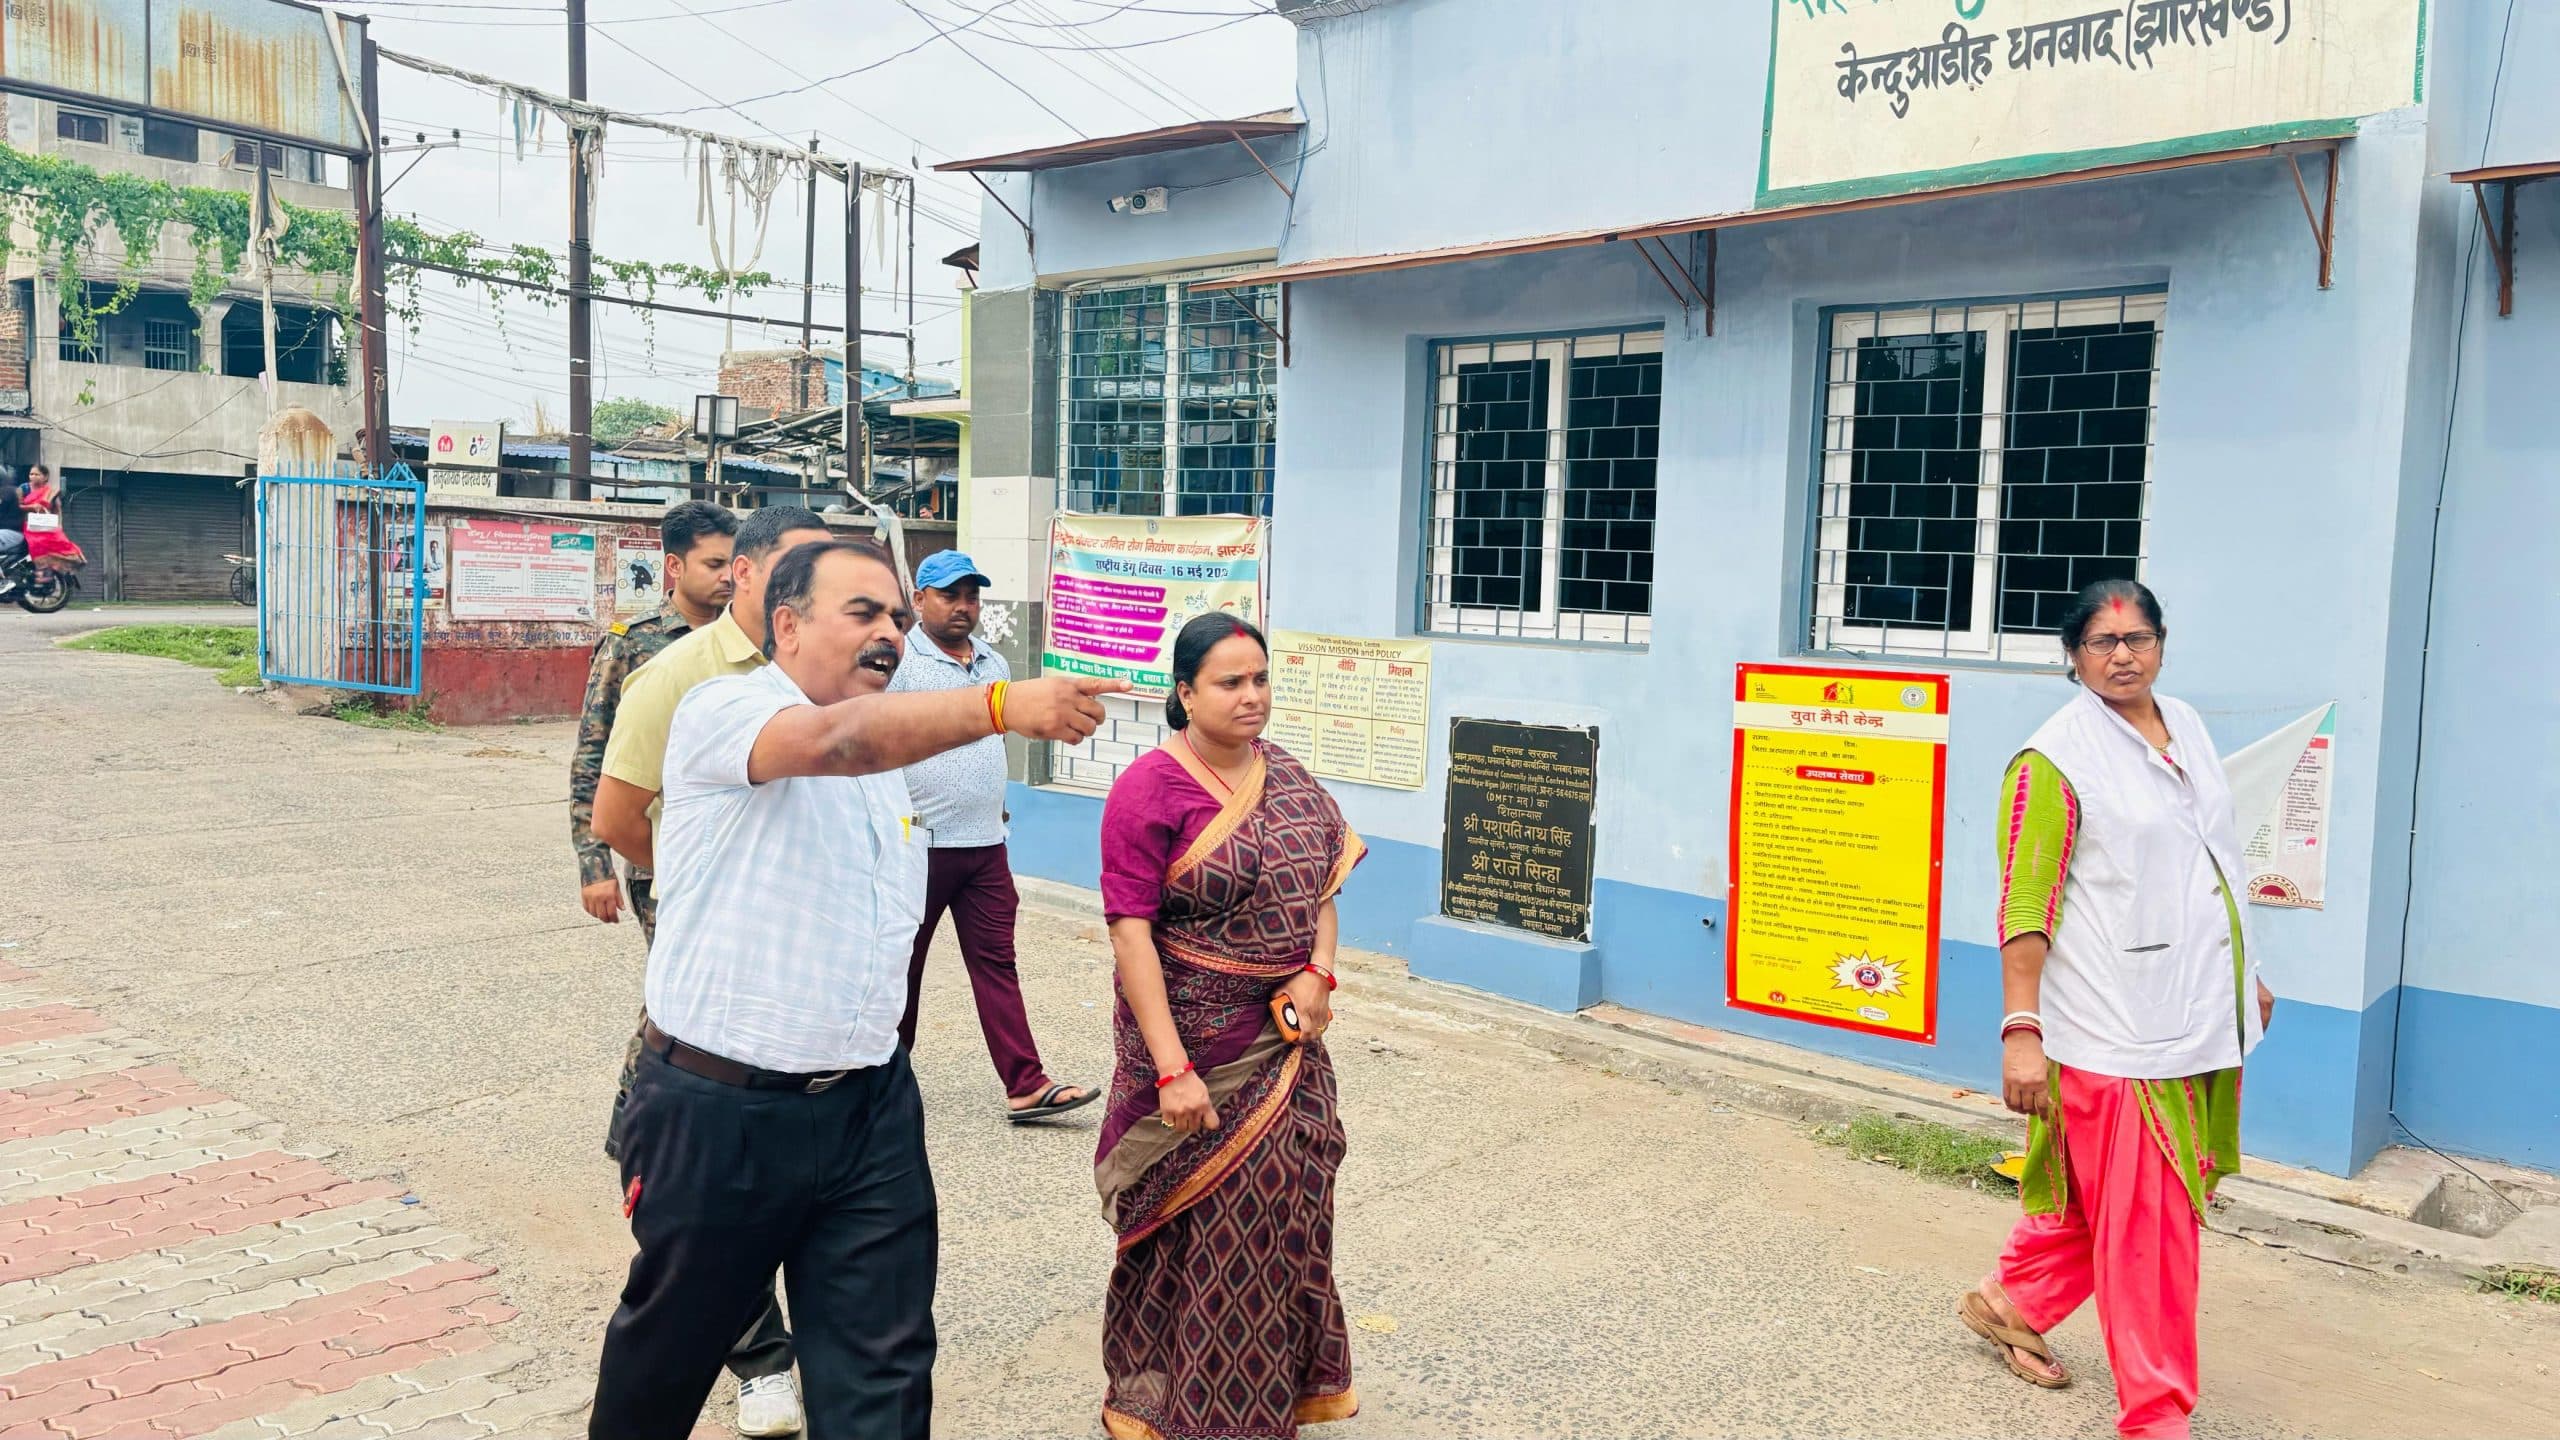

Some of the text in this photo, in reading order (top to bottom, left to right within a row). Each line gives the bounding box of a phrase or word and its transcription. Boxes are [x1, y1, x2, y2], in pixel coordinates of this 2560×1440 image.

[1835, 0, 2291, 119] केन्दुआडीह धनबाद (झारखण्ड)
[1100, 536, 1125, 550] जनित
[1128, 537, 1143, 552] रोग
[1145, 538, 1175, 553] नियंत्रण
[1095, 558, 1120, 572] राष्ट्रीय
[1171, 566, 1183, 577] 16
[1187, 564, 1202, 579] मई
[1298, 643, 1401, 659] VISSION MISSION and POLICY
[1337, 658, 1357, 672] नीति
[1388, 662, 1414, 677] मिशन
[1333, 719, 1353, 729] Mission
[1791, 709, 1884, 728] युवा मैत्री केन्द्र
[1528, 749, 1558, 760] सरकार
[1497, 804, 1543, 821] शिलान्यास
[1537, 799, 1549, 809] का
[1464, 813, 1573, 848] श्री पशुपति नाथ सिंह
[1472, 850, 1562, 883] श्री राज सिन्हा
